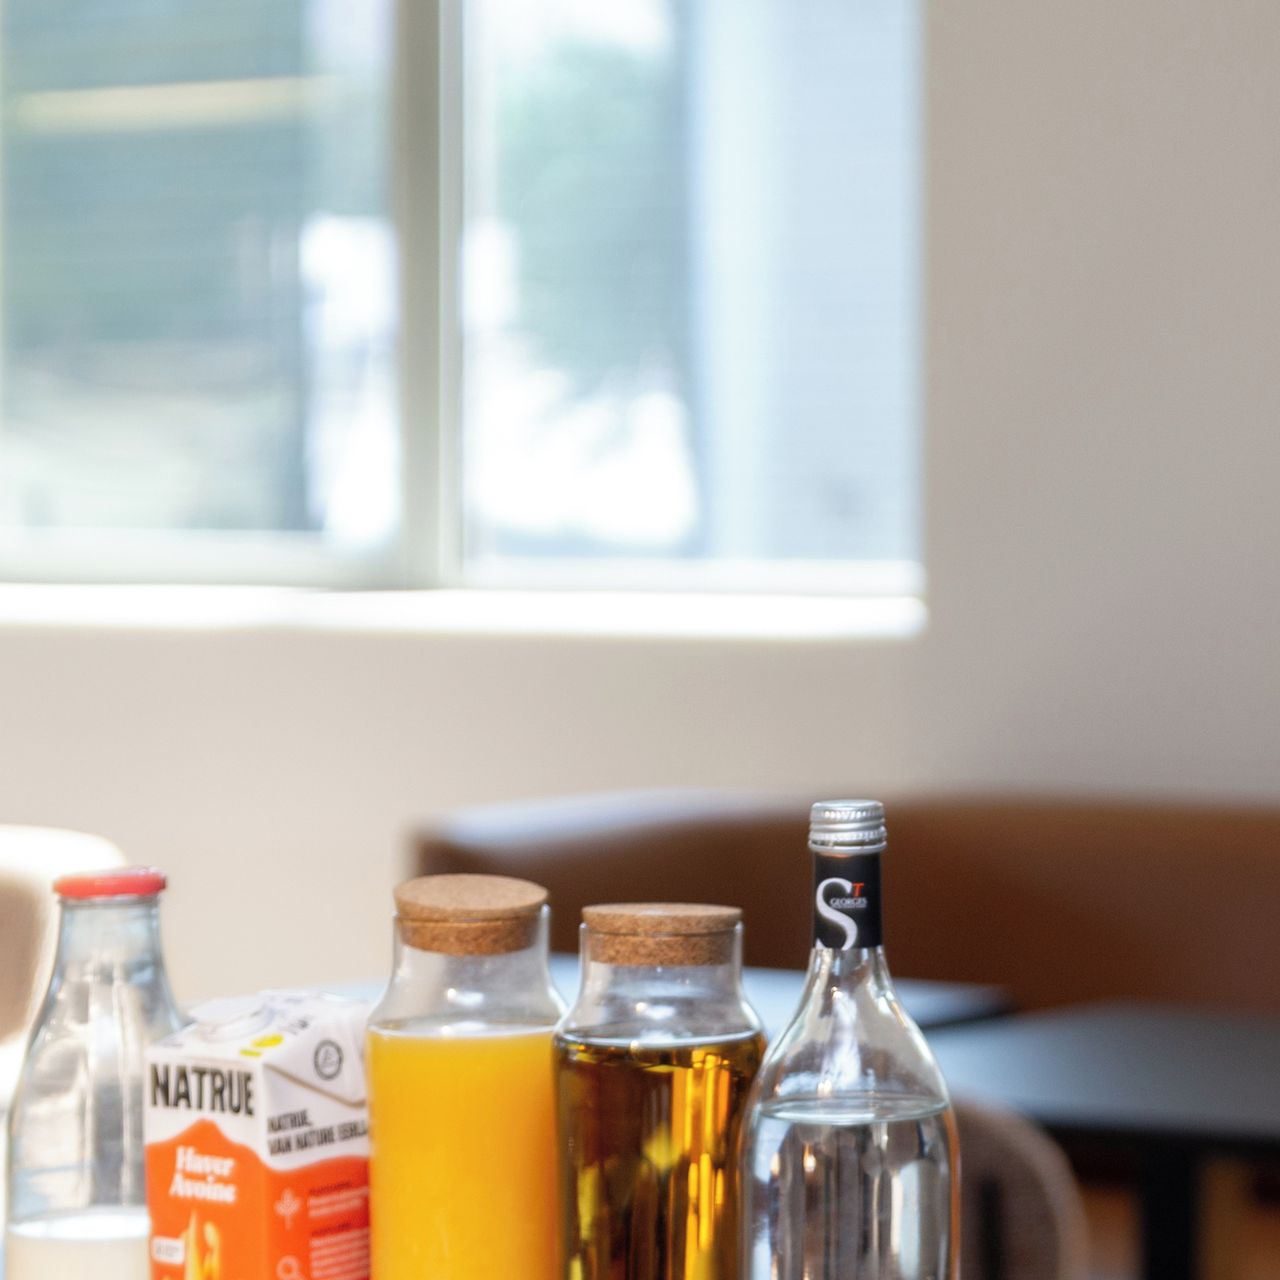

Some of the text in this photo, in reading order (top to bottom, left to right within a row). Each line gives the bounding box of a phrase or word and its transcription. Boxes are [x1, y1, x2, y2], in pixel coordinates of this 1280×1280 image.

[150, 1063, 254, 1116] NATRUE
[295, 1126, 335, 1150] NATURE
[176, 1145, 235, 1177] Haver
[169, 1171, 236, 1204] Avoine
